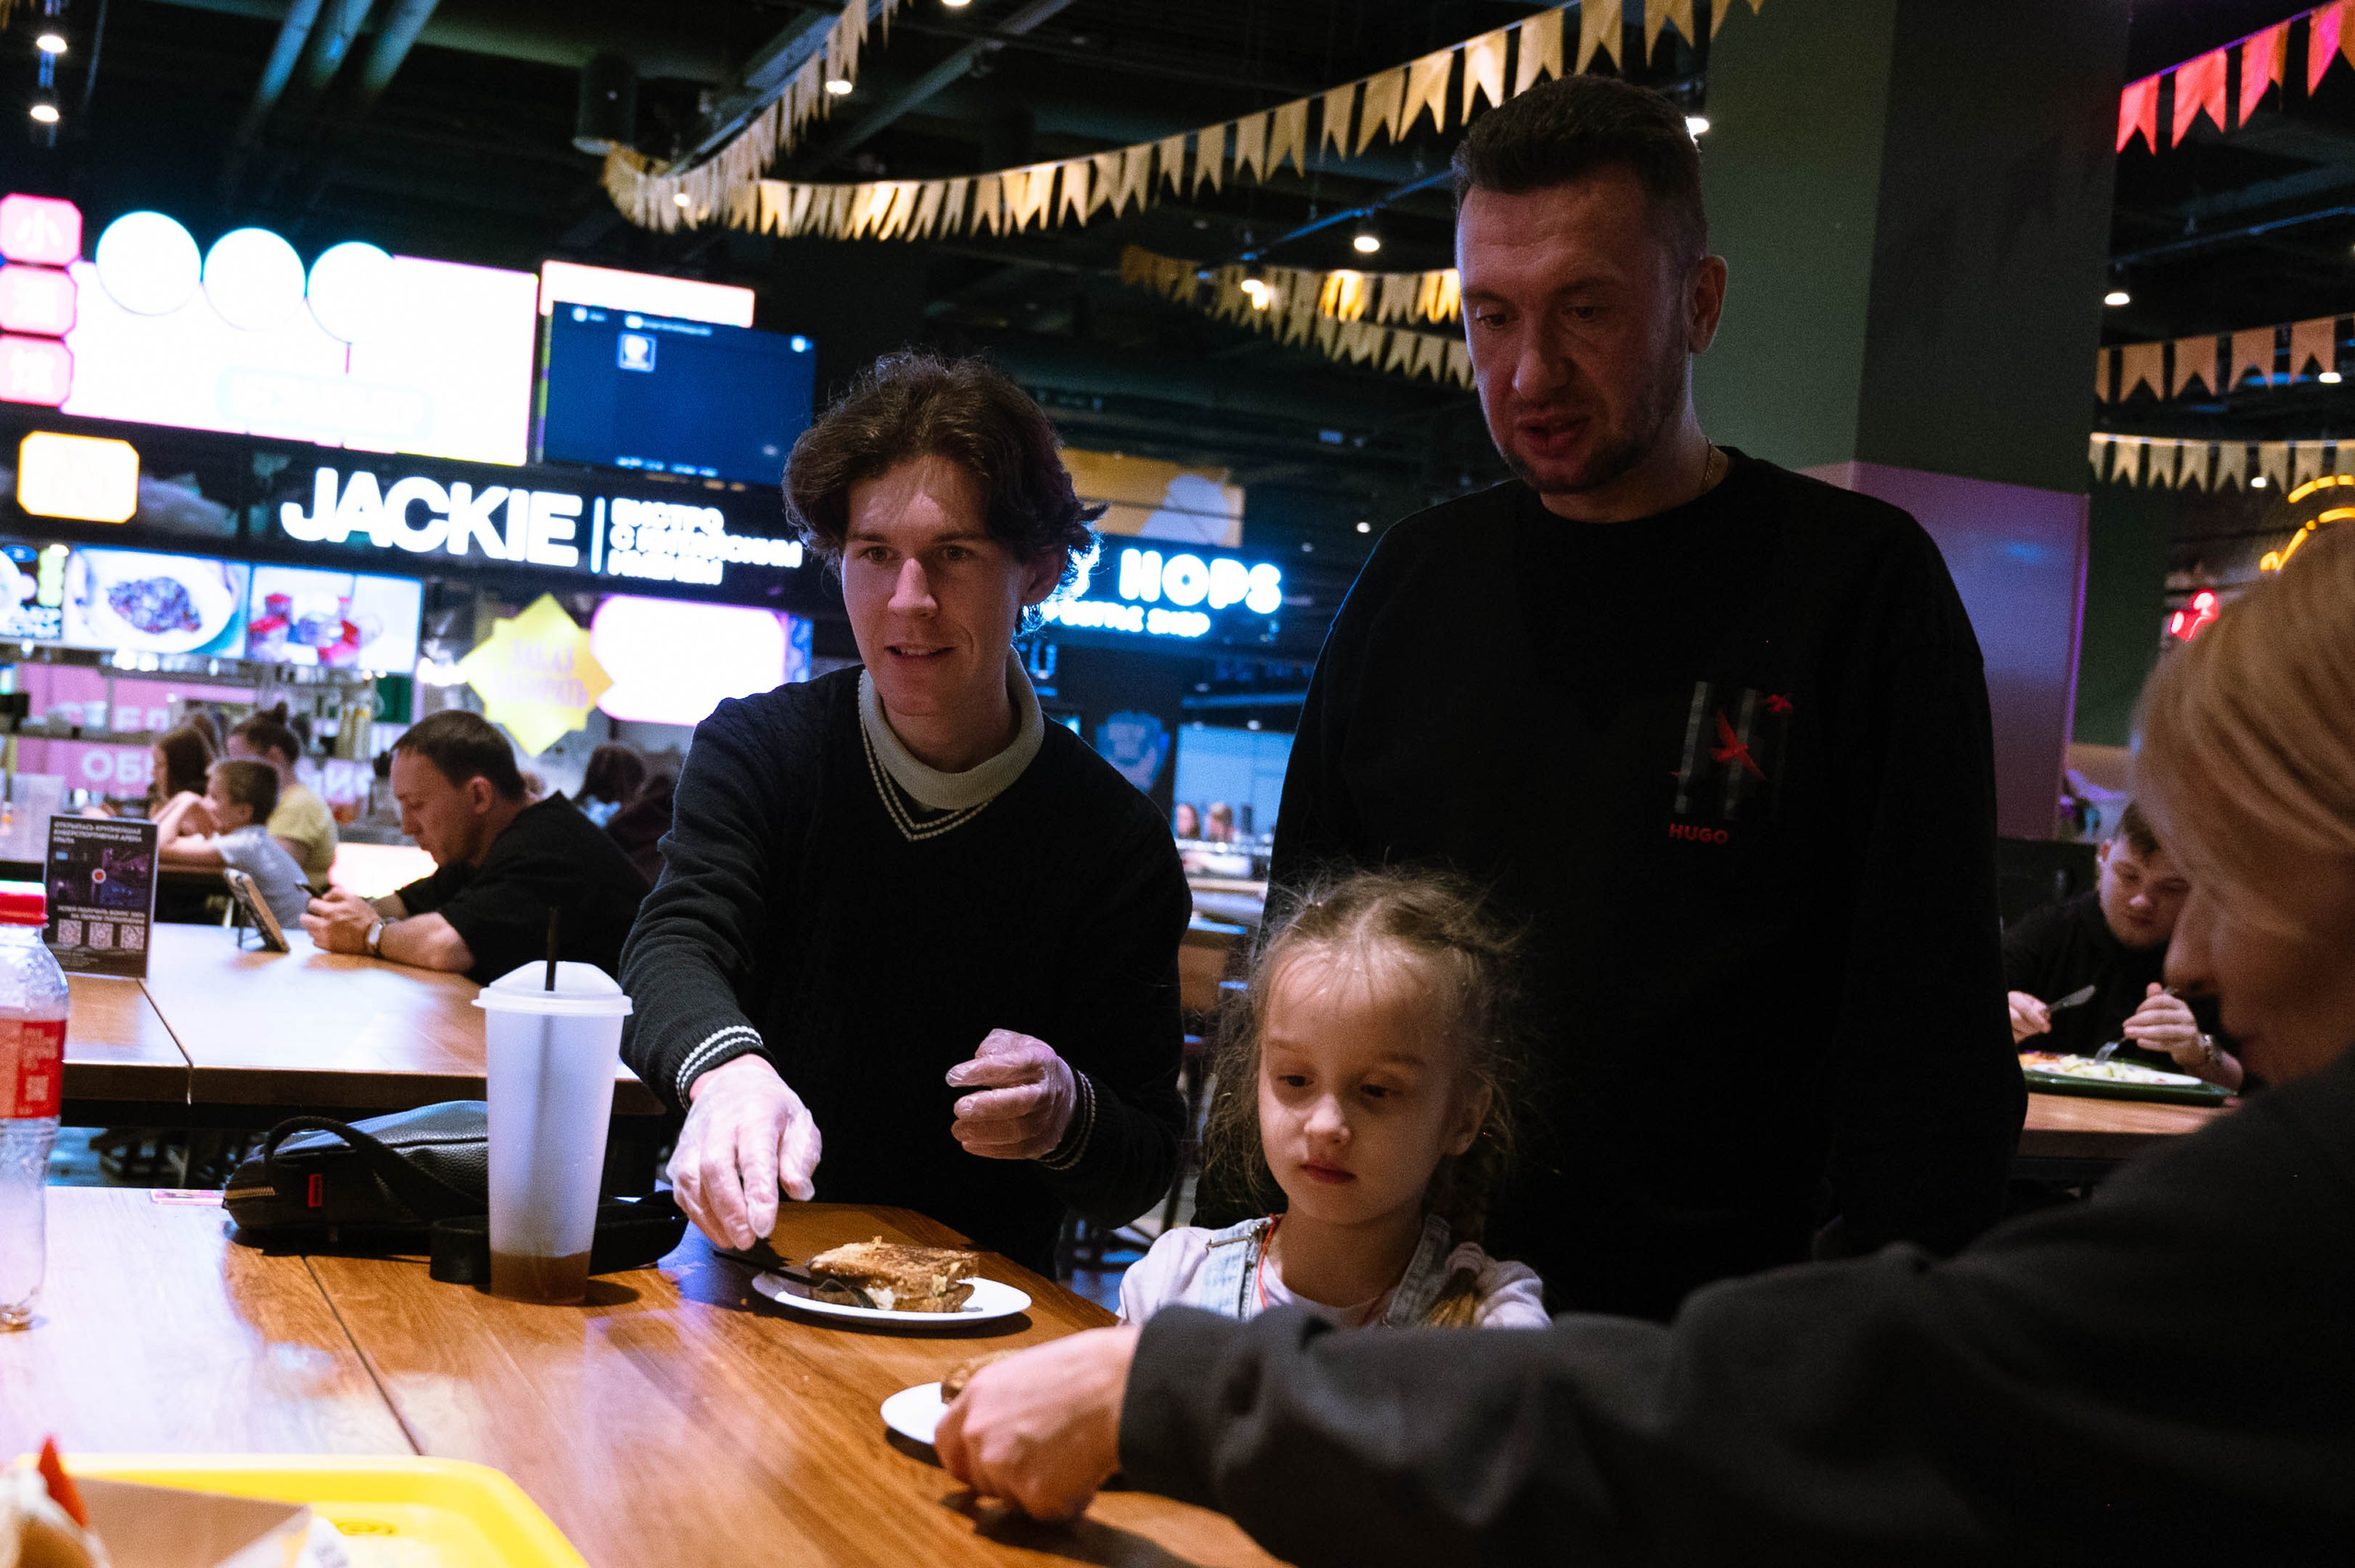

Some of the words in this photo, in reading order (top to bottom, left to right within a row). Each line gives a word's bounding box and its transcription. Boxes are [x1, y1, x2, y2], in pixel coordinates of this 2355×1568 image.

[281, 467, 582, 567] JACKIE
[1120, 548, 1281, 613] HOPS
[1669, 824, 1729, 844] HUGO
